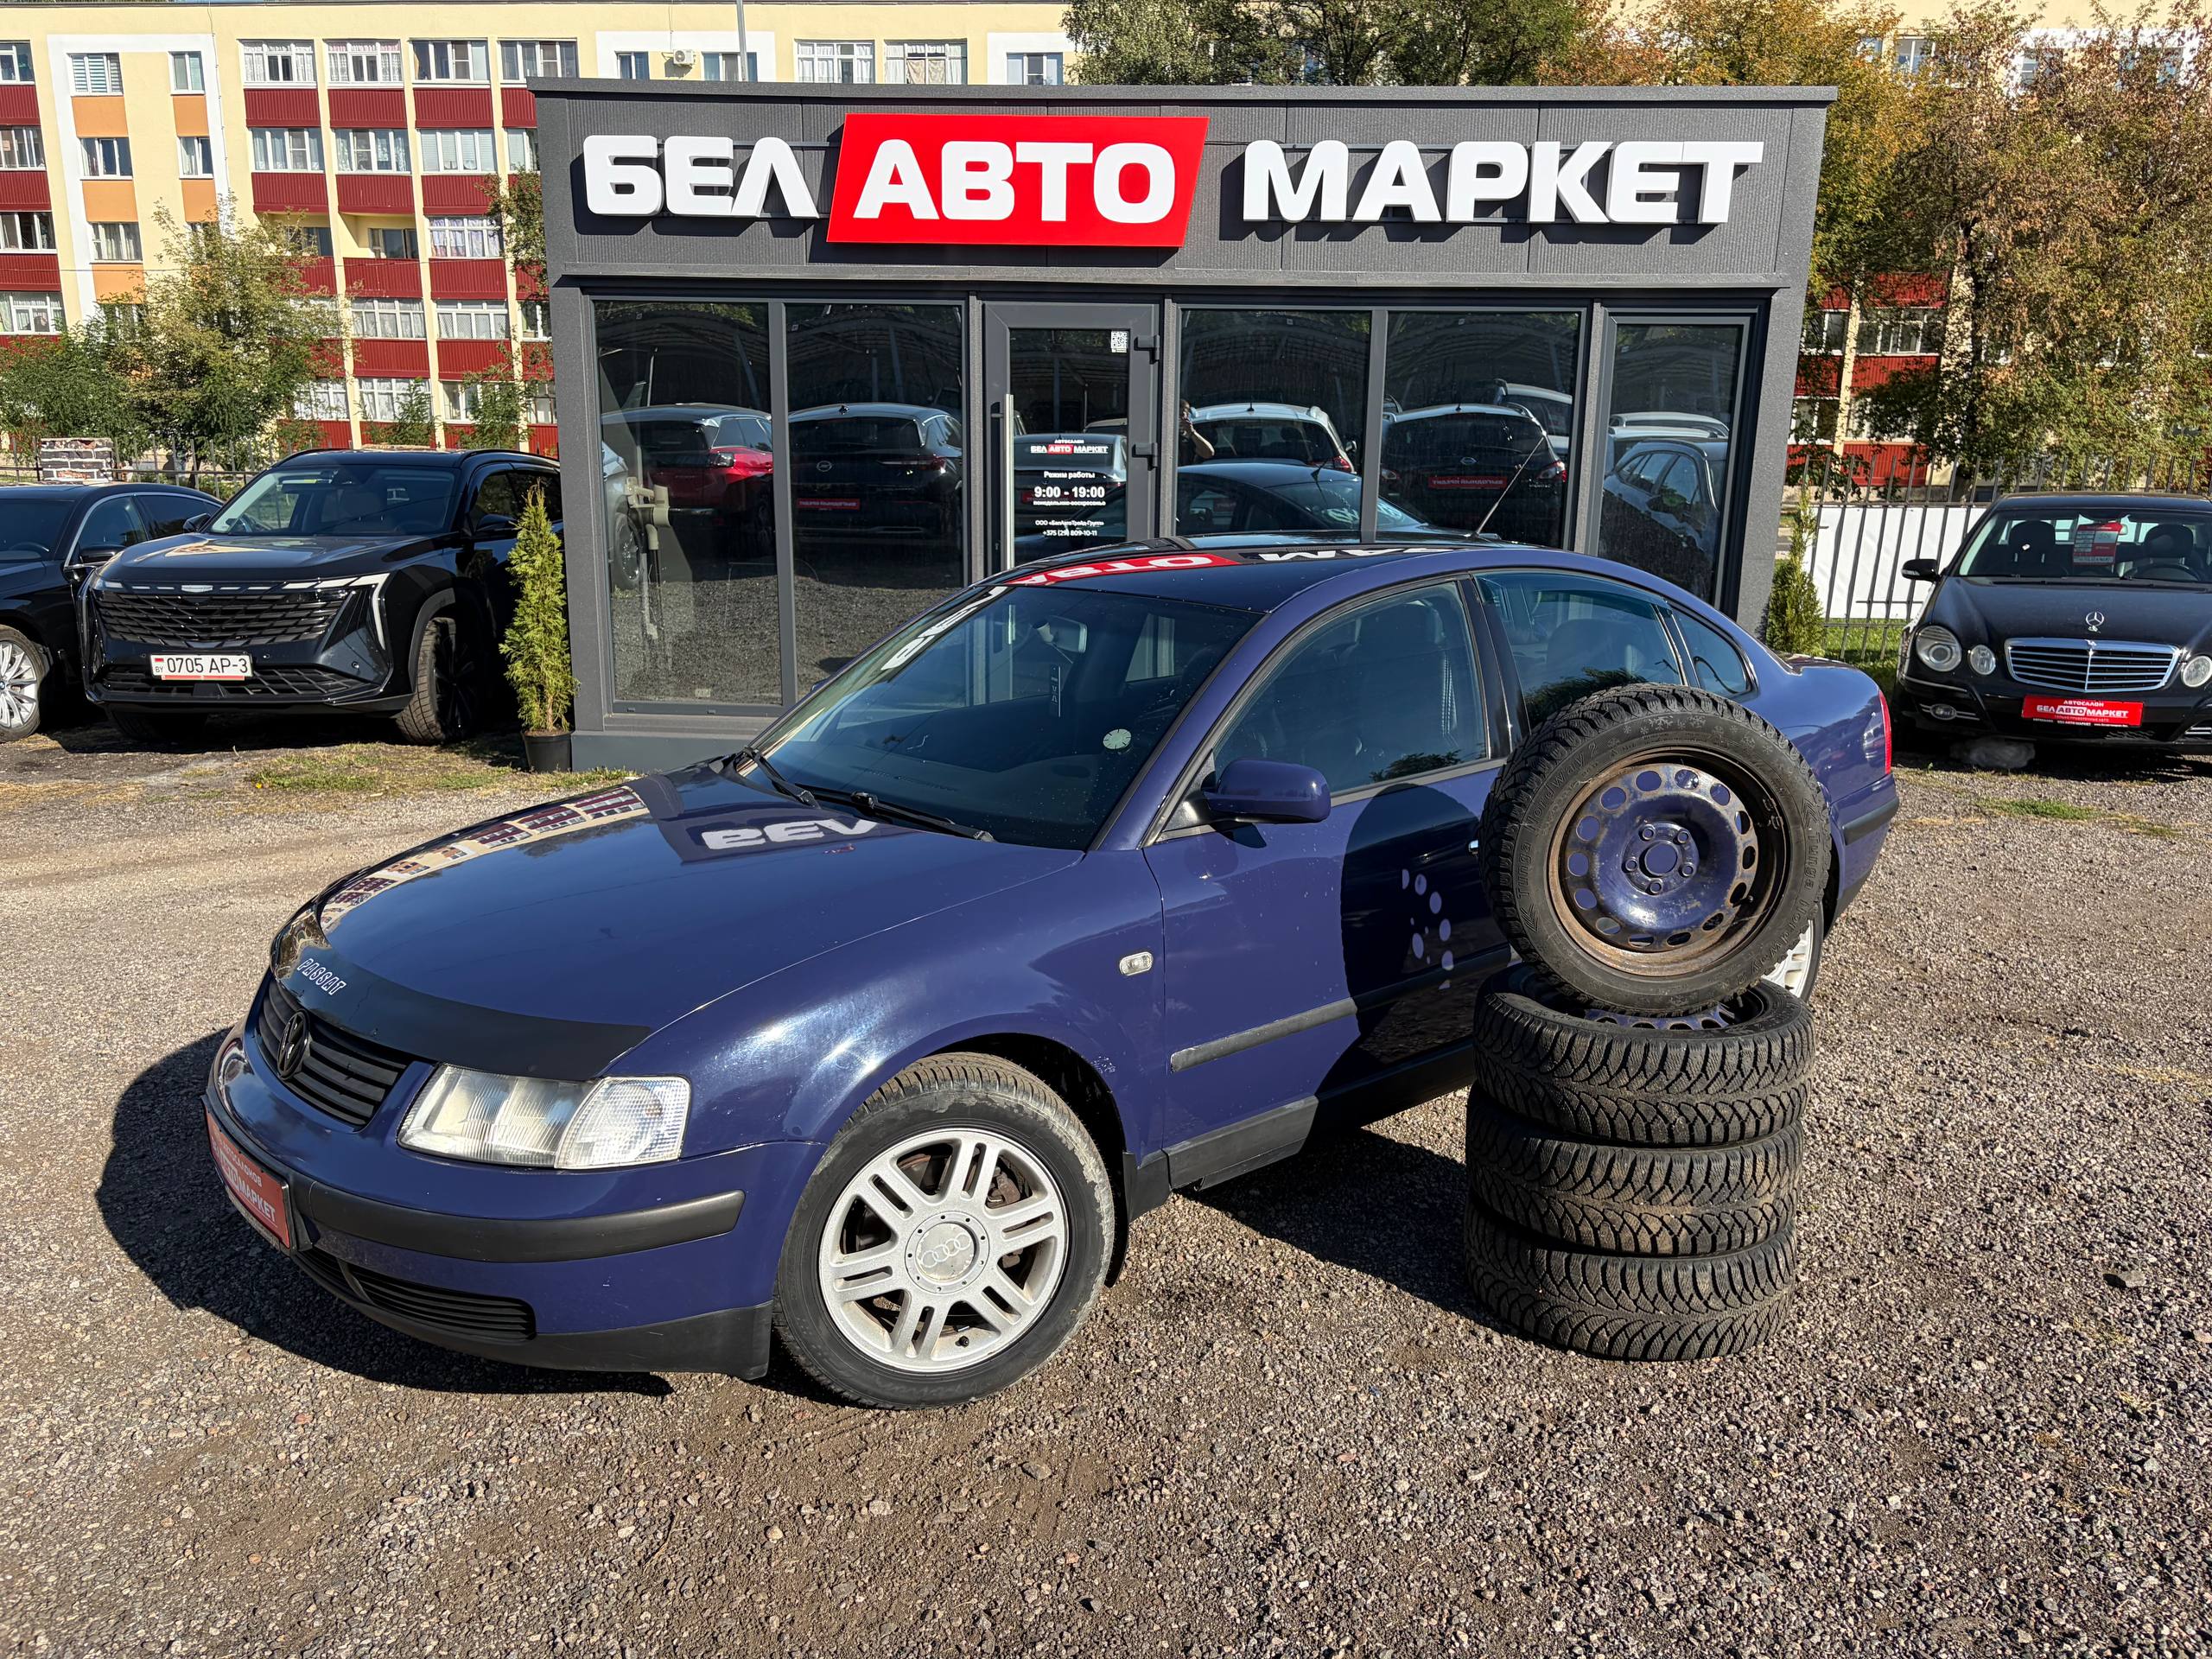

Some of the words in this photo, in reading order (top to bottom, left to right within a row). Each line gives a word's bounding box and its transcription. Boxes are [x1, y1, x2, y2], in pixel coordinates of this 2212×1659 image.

[583, 135, 820, 219] БЕЛ
[853, 138, 1176, 224] АВТО
[1243, 139, 1764, 224] МАРКЕТ
[1031, 445, 1047, 454] БЕЛ
[1074, 445, 1109, 454] МАРКЕТ
[1069, 471, 1096, 480] работы
[1034, 486, 1061, 498] 9:00
[1071, 486, 1105, 498] 19:00
[167, 658, 204, 673] 0705
[208, 658, 248, 673] AP-3
[2037, 704, 2056, 714] БЕЛ
[2057, 706, 2085, 715] АВТО
[2086, 709, 2129, 717] МАРКЕТ
[1516, 842, 1532, 899] Tunga
[1587, 742, 1598, 756] 2
[1804, 833, 1821, 891] Tunga
[296, 957, 347, 995] PASSAT
[238, 1176, 276, 1223] МАРКЕТ
